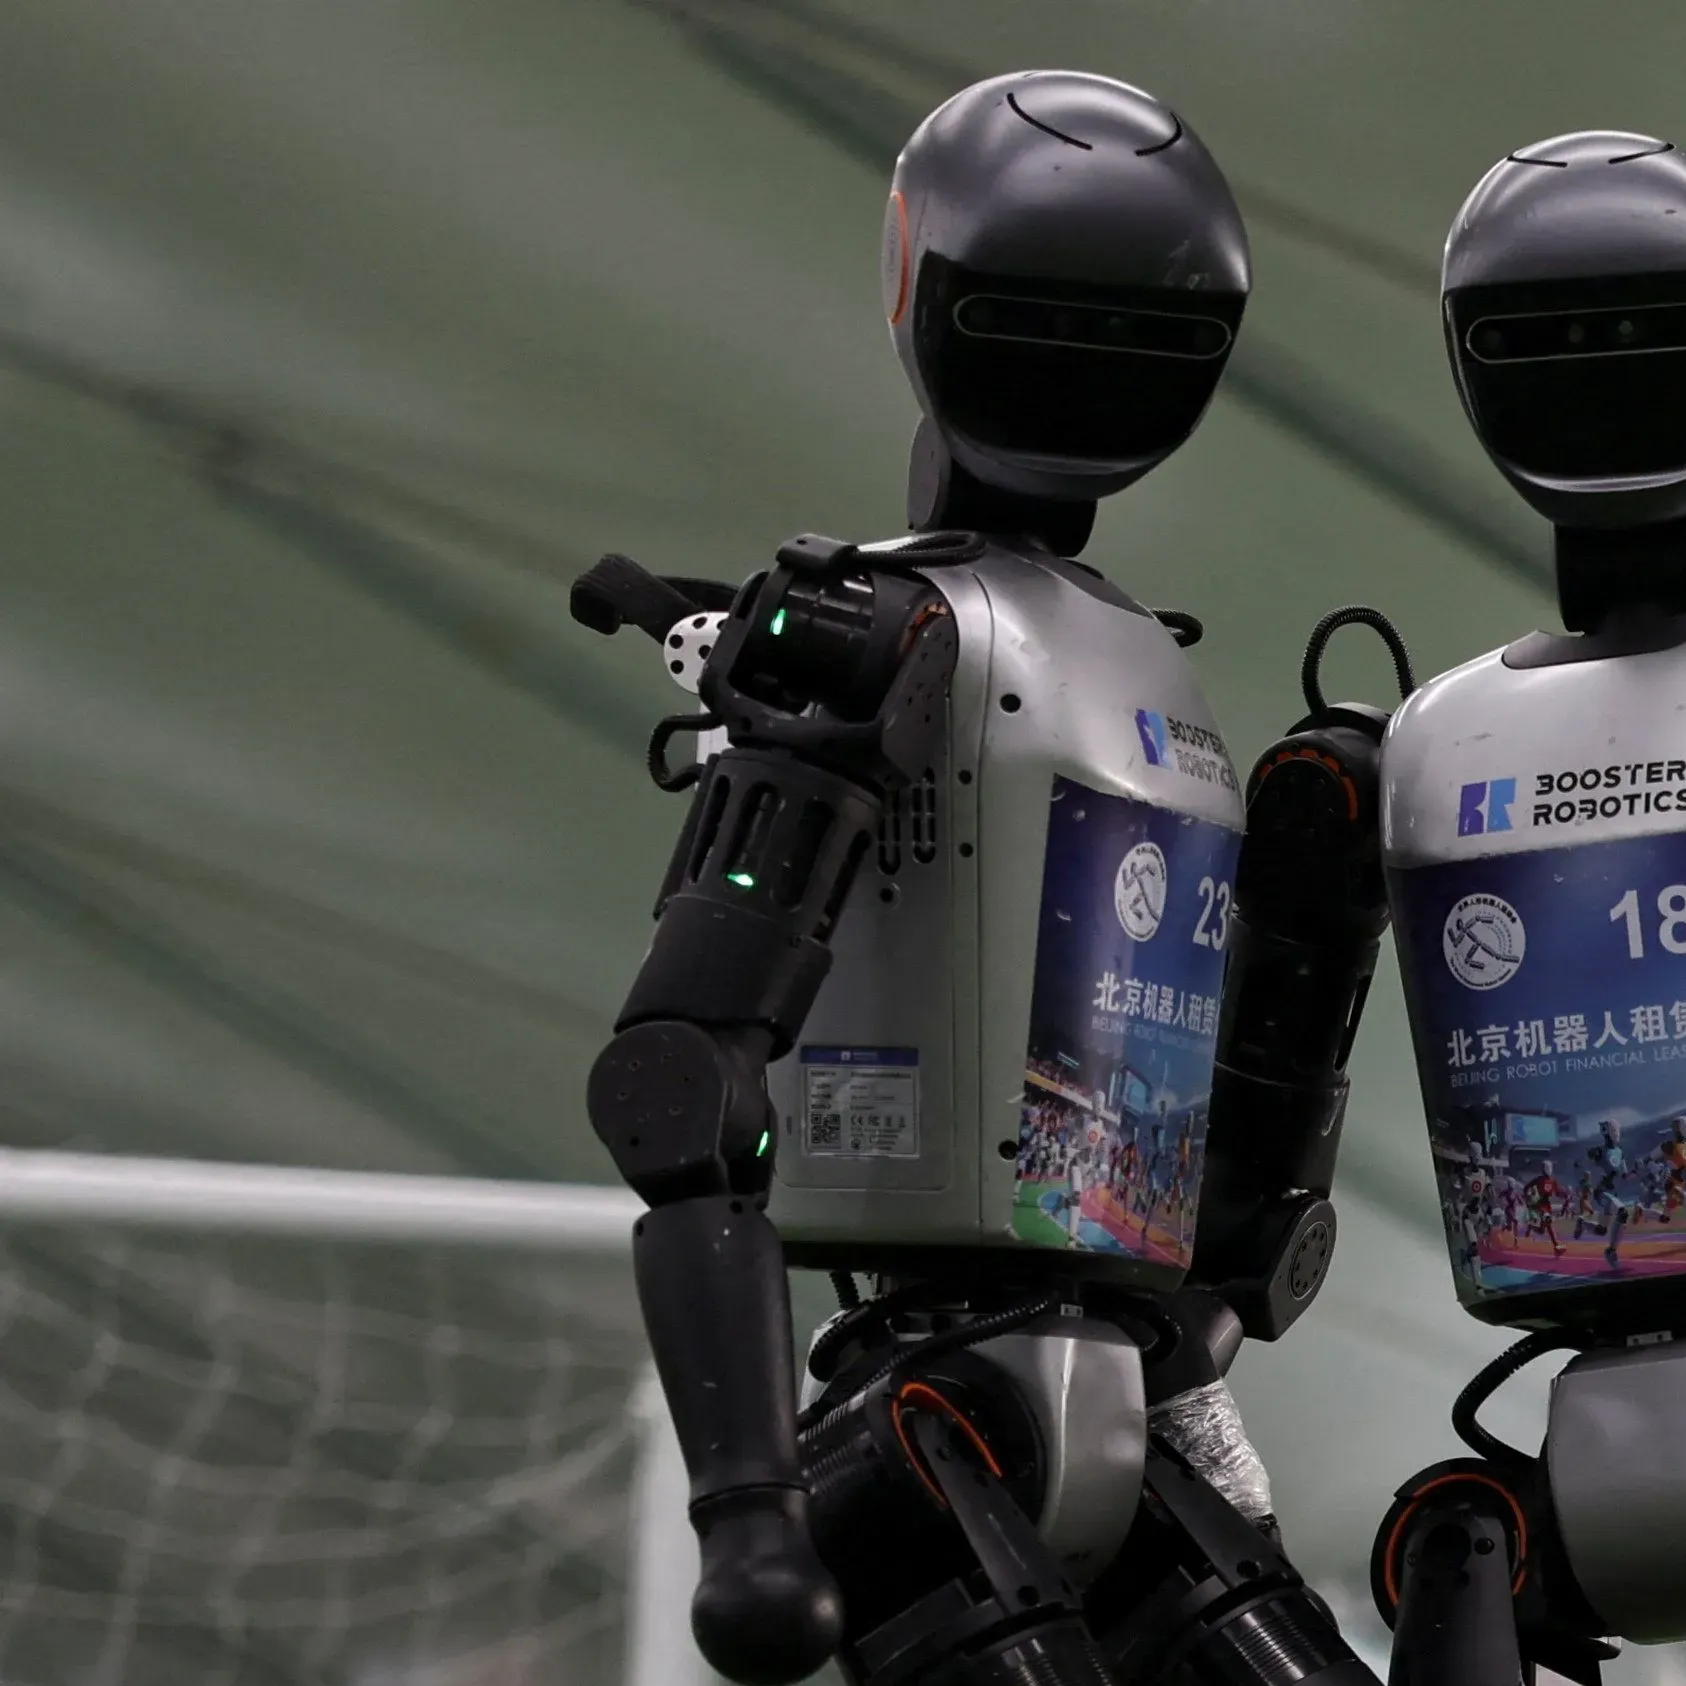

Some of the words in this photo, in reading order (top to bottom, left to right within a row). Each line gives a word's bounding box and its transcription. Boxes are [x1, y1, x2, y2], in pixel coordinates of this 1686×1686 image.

[1092, 970, 1220, 1036] 北京机器人租赁
[1450, 1067, 1500, 1088] BEIJING
[1506, 1060, 1558, 1081] ROBOT
[1565, 1050, 1647, 1073] FINANCIAL
